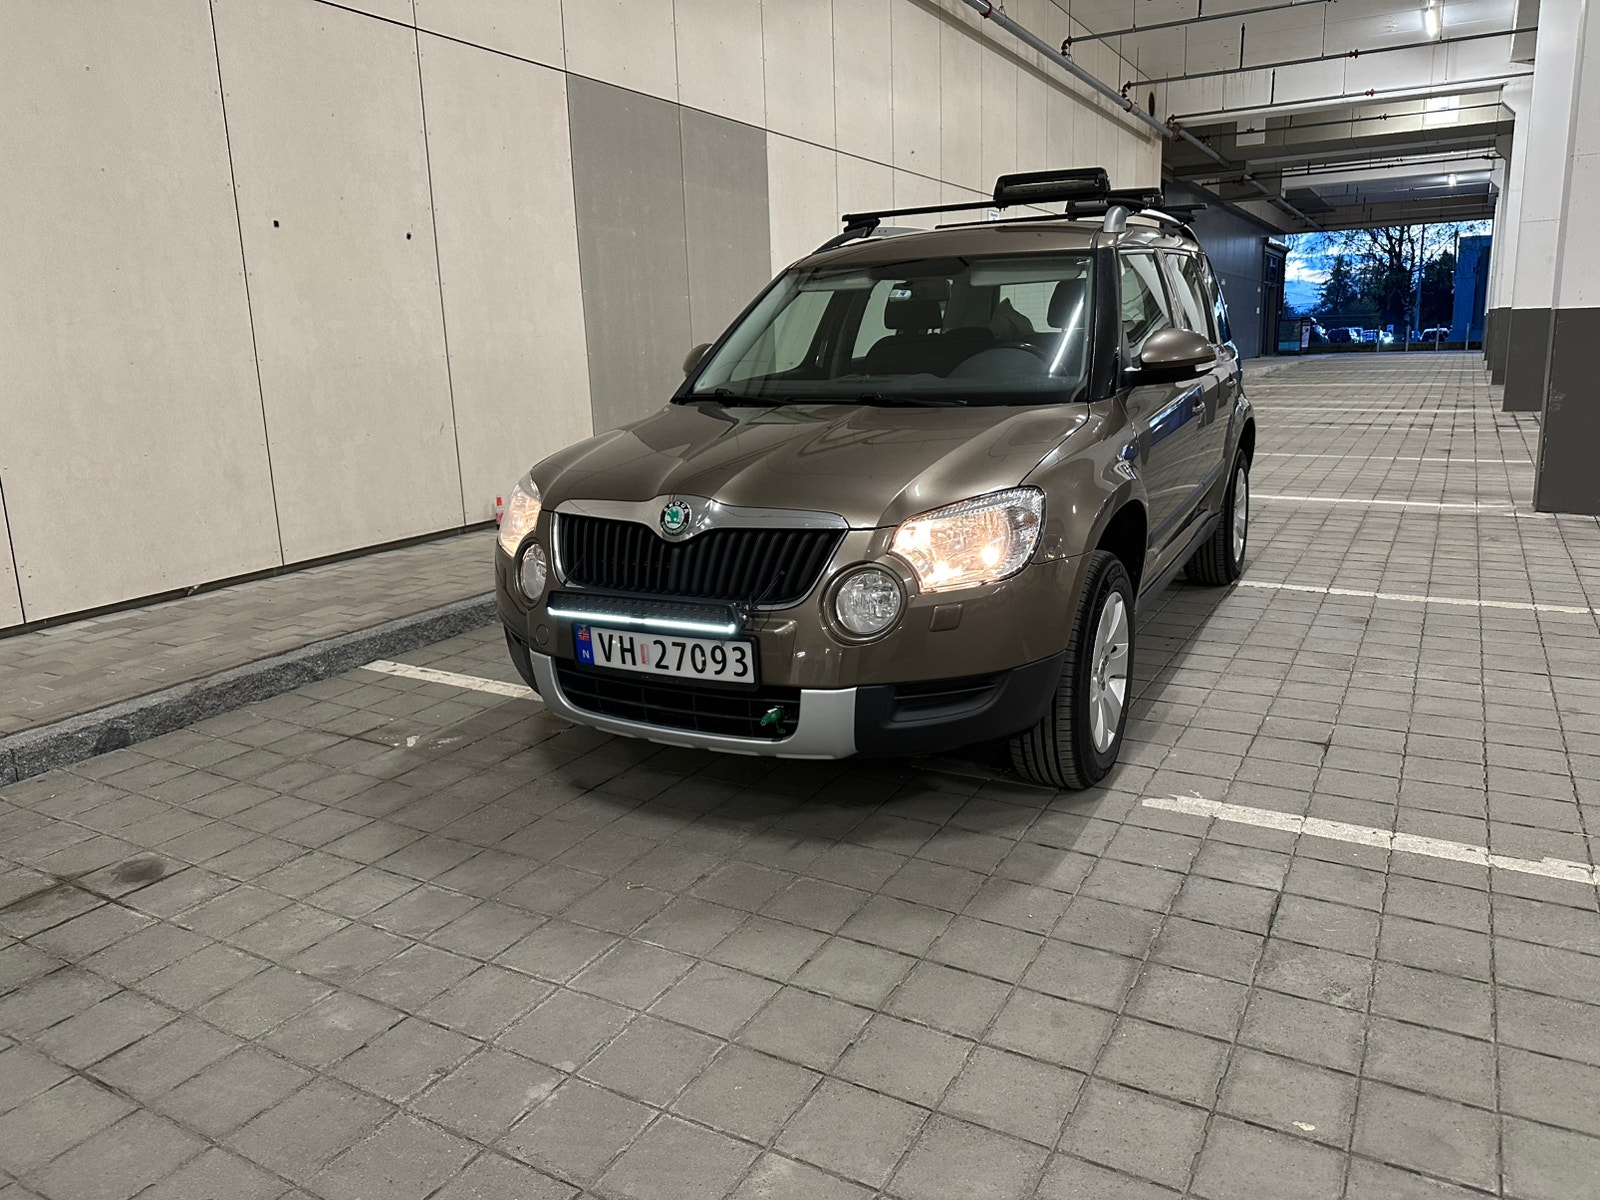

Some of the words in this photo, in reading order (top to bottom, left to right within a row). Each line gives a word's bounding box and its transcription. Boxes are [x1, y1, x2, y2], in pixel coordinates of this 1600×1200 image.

[582, 649, 590, 659] N
[598, 632, 637, 666] VH
[653, 639, 748, 677] 27093
